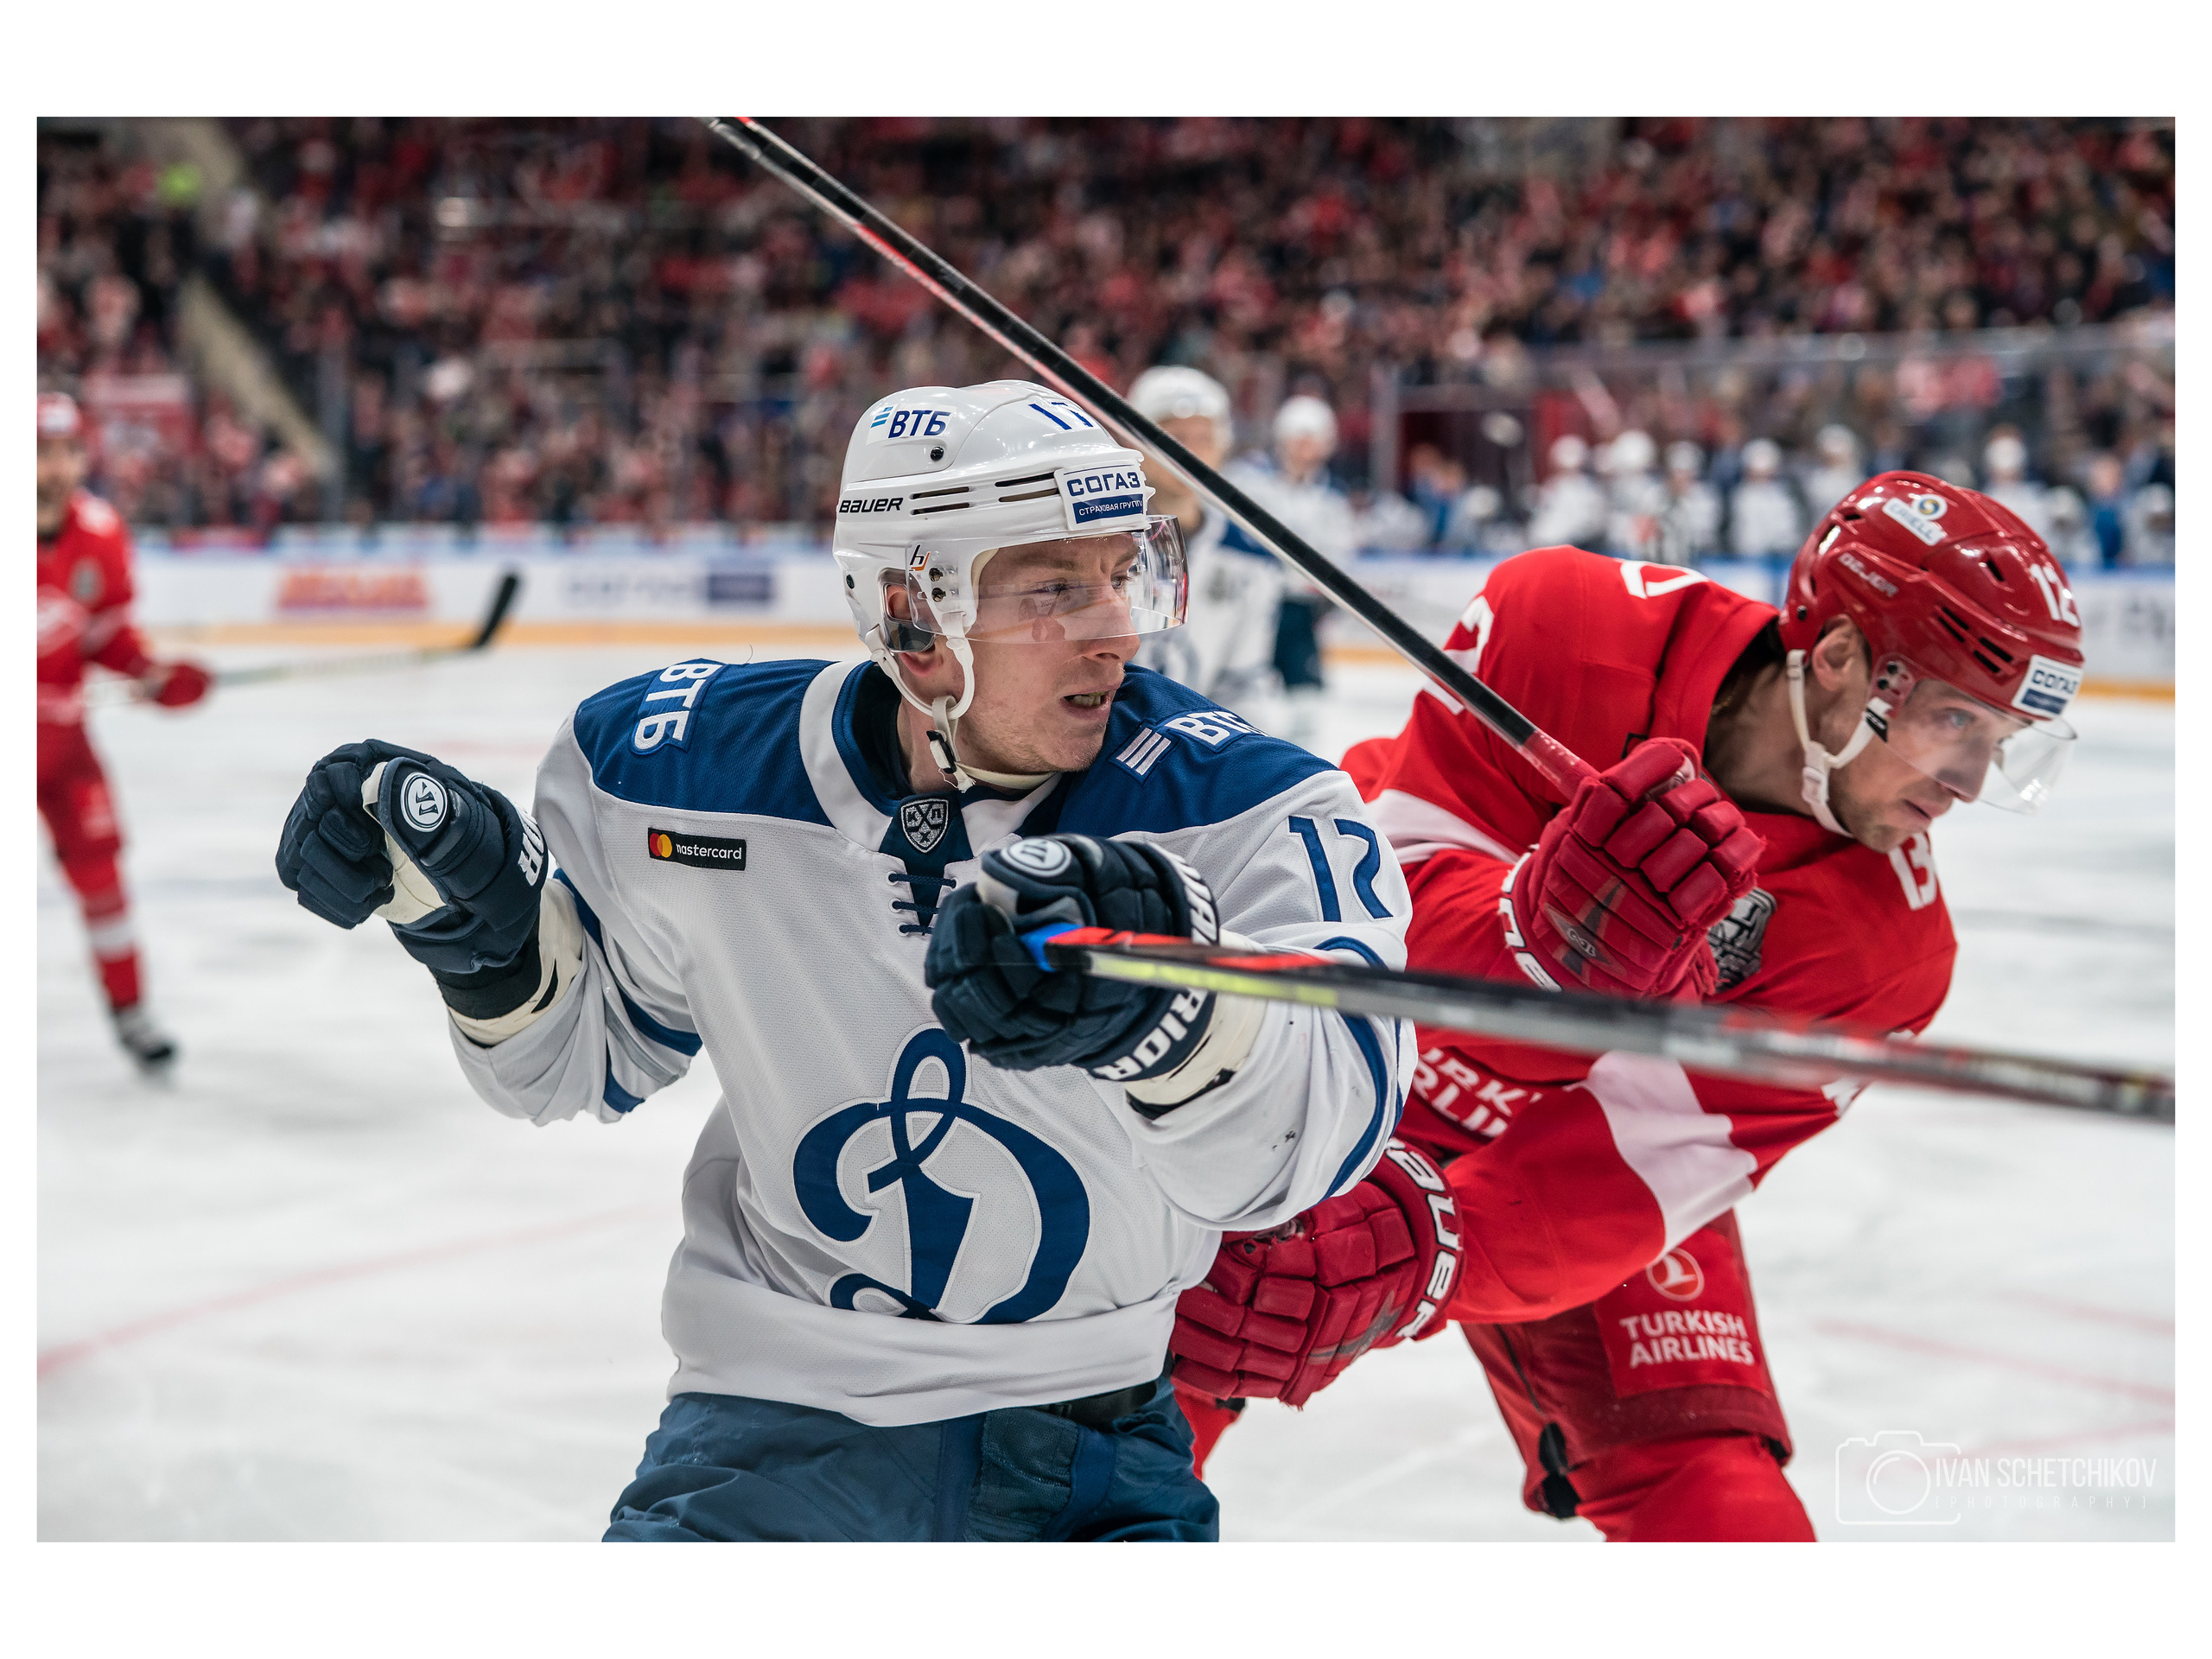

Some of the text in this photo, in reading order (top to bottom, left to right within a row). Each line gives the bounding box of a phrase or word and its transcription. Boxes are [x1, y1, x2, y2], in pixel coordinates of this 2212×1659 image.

[887, 409, 951, 439] ВТБ
[1066, 472, 1141, 497] СОГАЗ
[1078, 499, 1143, 516] СТРАХОВАЯ ГРУПП
[634, 663, 723, 750] ВТБ
[1384, 1136, 1464, 1339] AUER
[1618, 1309, 1749, 1341] TURKISH
[1629, 1335, 1756, 1369] AIRLINES
